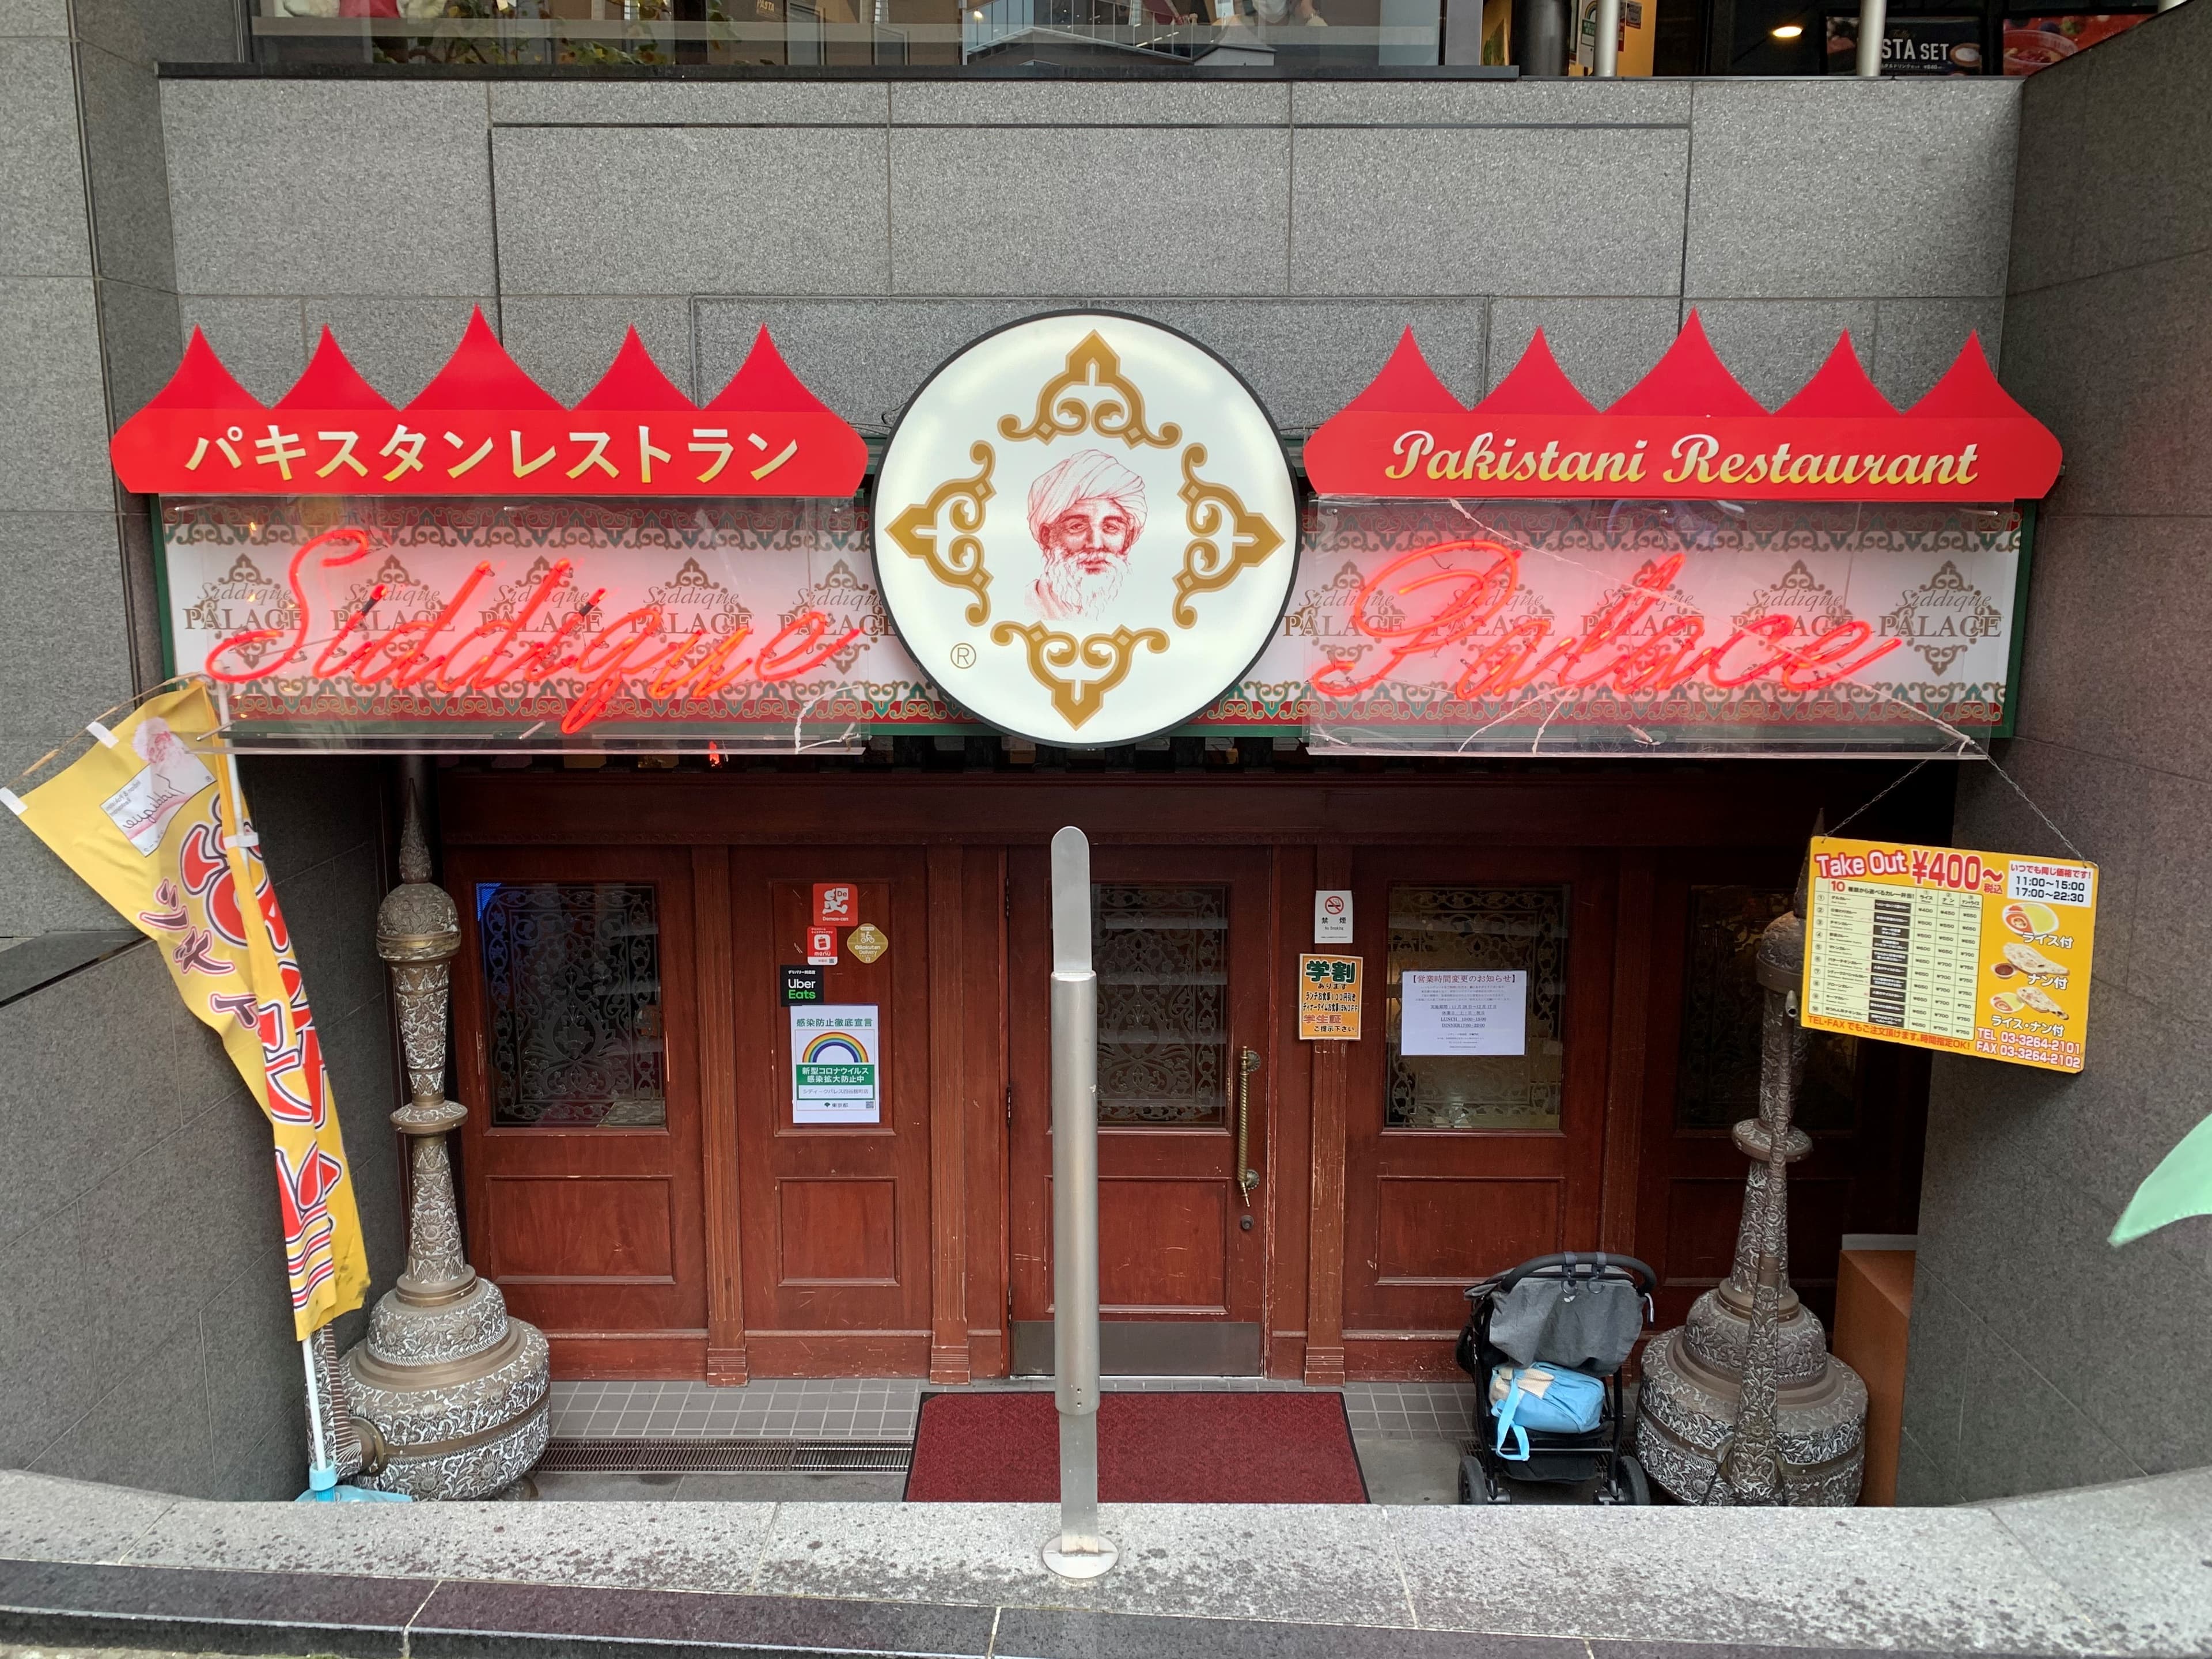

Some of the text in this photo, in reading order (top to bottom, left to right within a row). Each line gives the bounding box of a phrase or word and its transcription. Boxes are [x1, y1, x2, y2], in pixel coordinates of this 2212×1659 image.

[1881, 39, 1949, 60] STA SET
[185, 425, 798, 483] パキスタンレストラン
[1385, 430, 1978, 484] Pakistani Restaurant
[643, 586, 738, 609] Siddique
[793, 588, 883, 612] Siddiqu
[1747, 589, 1842, 612] Siddique
[1896, 589, 1991, 612] Siddique
[1310, 539, 1902, 700] Palace
[1877, 615, 2002, 637] PALACE
[204, 529, 860, 734] Siddique
[1815, 852, 1866, 878] Take
[1868, 850, 1908, 876] Out
[1831, 881, 1845, 892] 10
[1984, 883, 2003, 895] 税込
[2022, 931, 2074, 949] ライス付
[1305, 960, 1356, 983] 学割
[2028, 974, 2068, 990] ナン付
[788, 979, 816, 988] Uber
[788, 990, 816, 999] Eats
[797, 1018, 873, 1027] 感染防止徹底宣言
[1303, 1014, 1342, 1024] 学生証
[1977, 1027, 2080, 1055] TEL 03-3264-2101
[1976, 1040, 2081, 1069] FAX 03-3264-2102
[802, 1067, 869, 1075] 新型コロナウイルス
